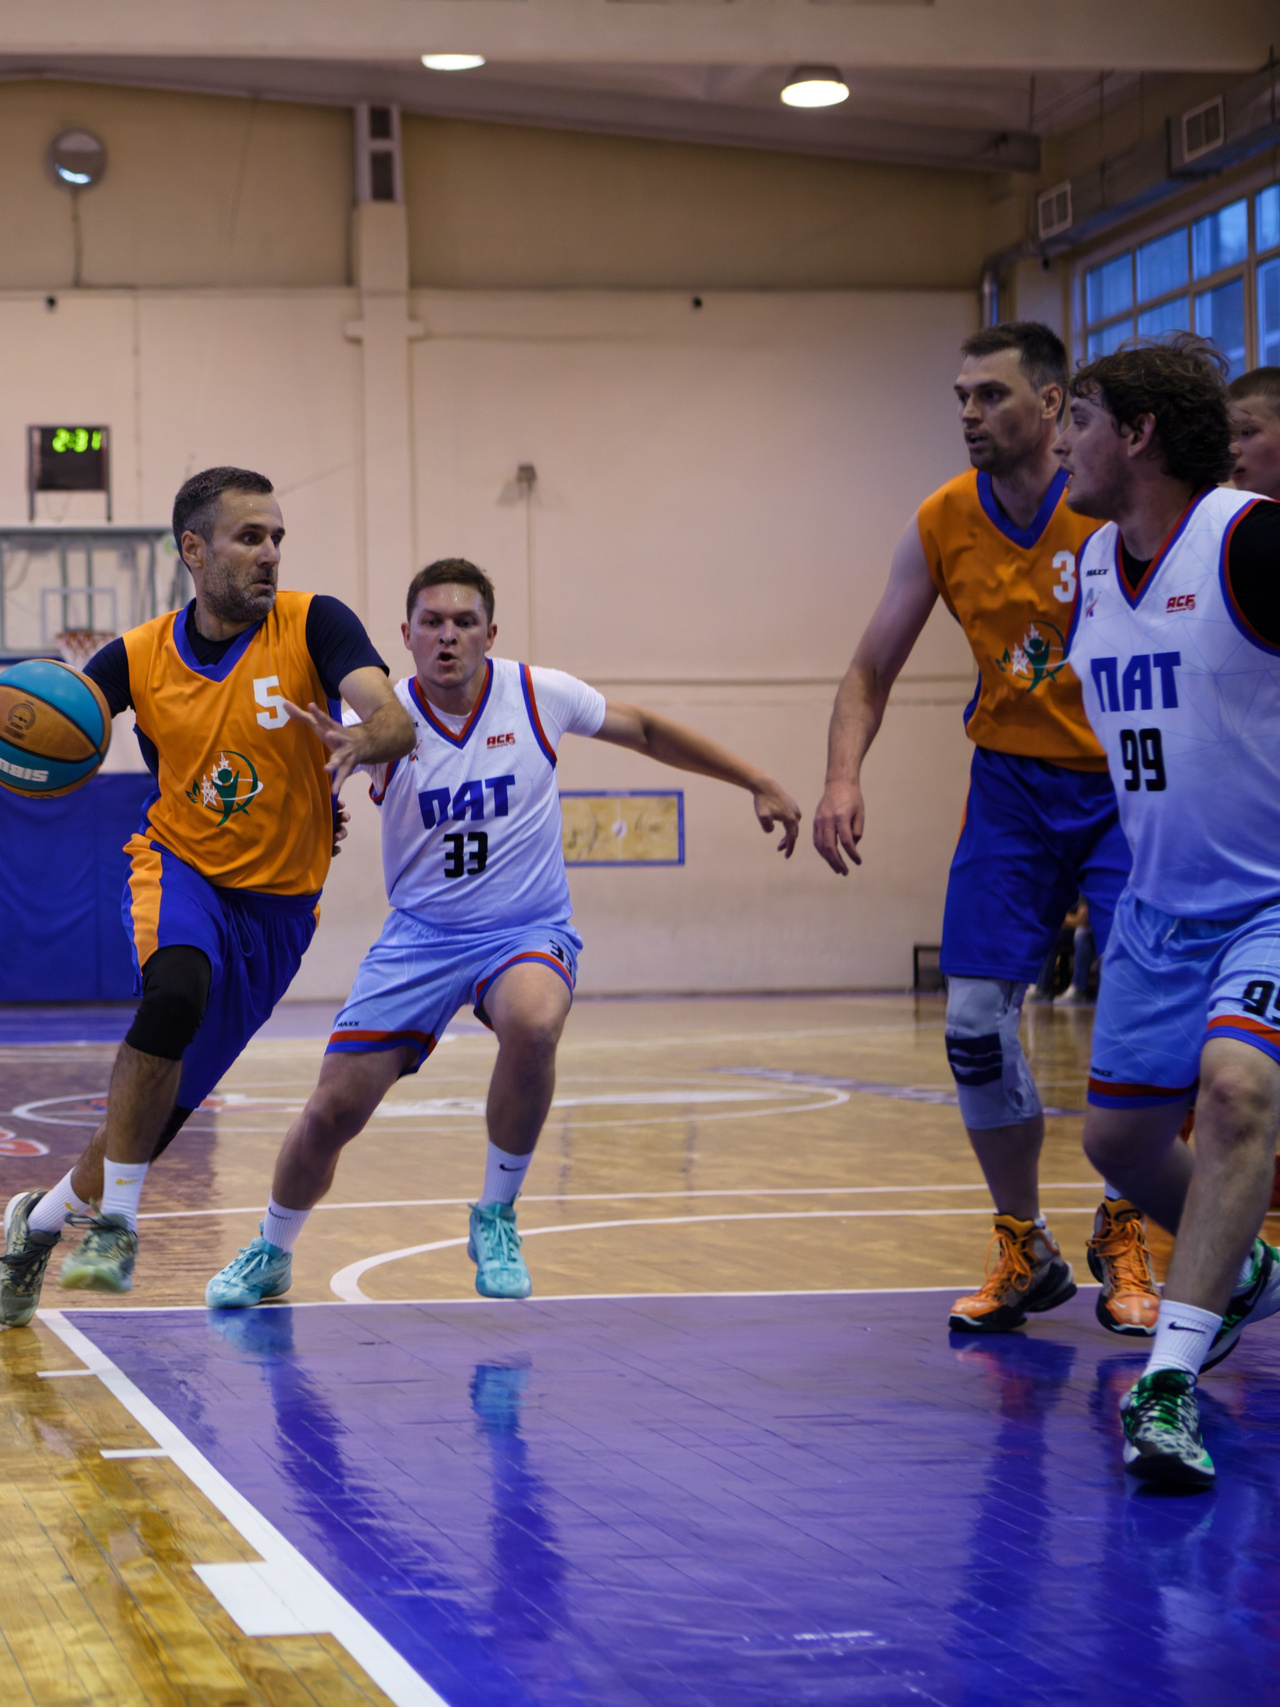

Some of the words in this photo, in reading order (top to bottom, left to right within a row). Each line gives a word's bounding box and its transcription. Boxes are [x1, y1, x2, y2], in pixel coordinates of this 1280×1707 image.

[52, 427, 102, 453] 2:31
[252, 675, 290, 730] 5
[1090, 651, 1181, 713] ПАТ
[1119, 728, 1167, 792] 99
[418, 774, 516, 830] ПАТ
[443, 831, 488, 878] 33
[1242, 980, 1280, 1026] 9
